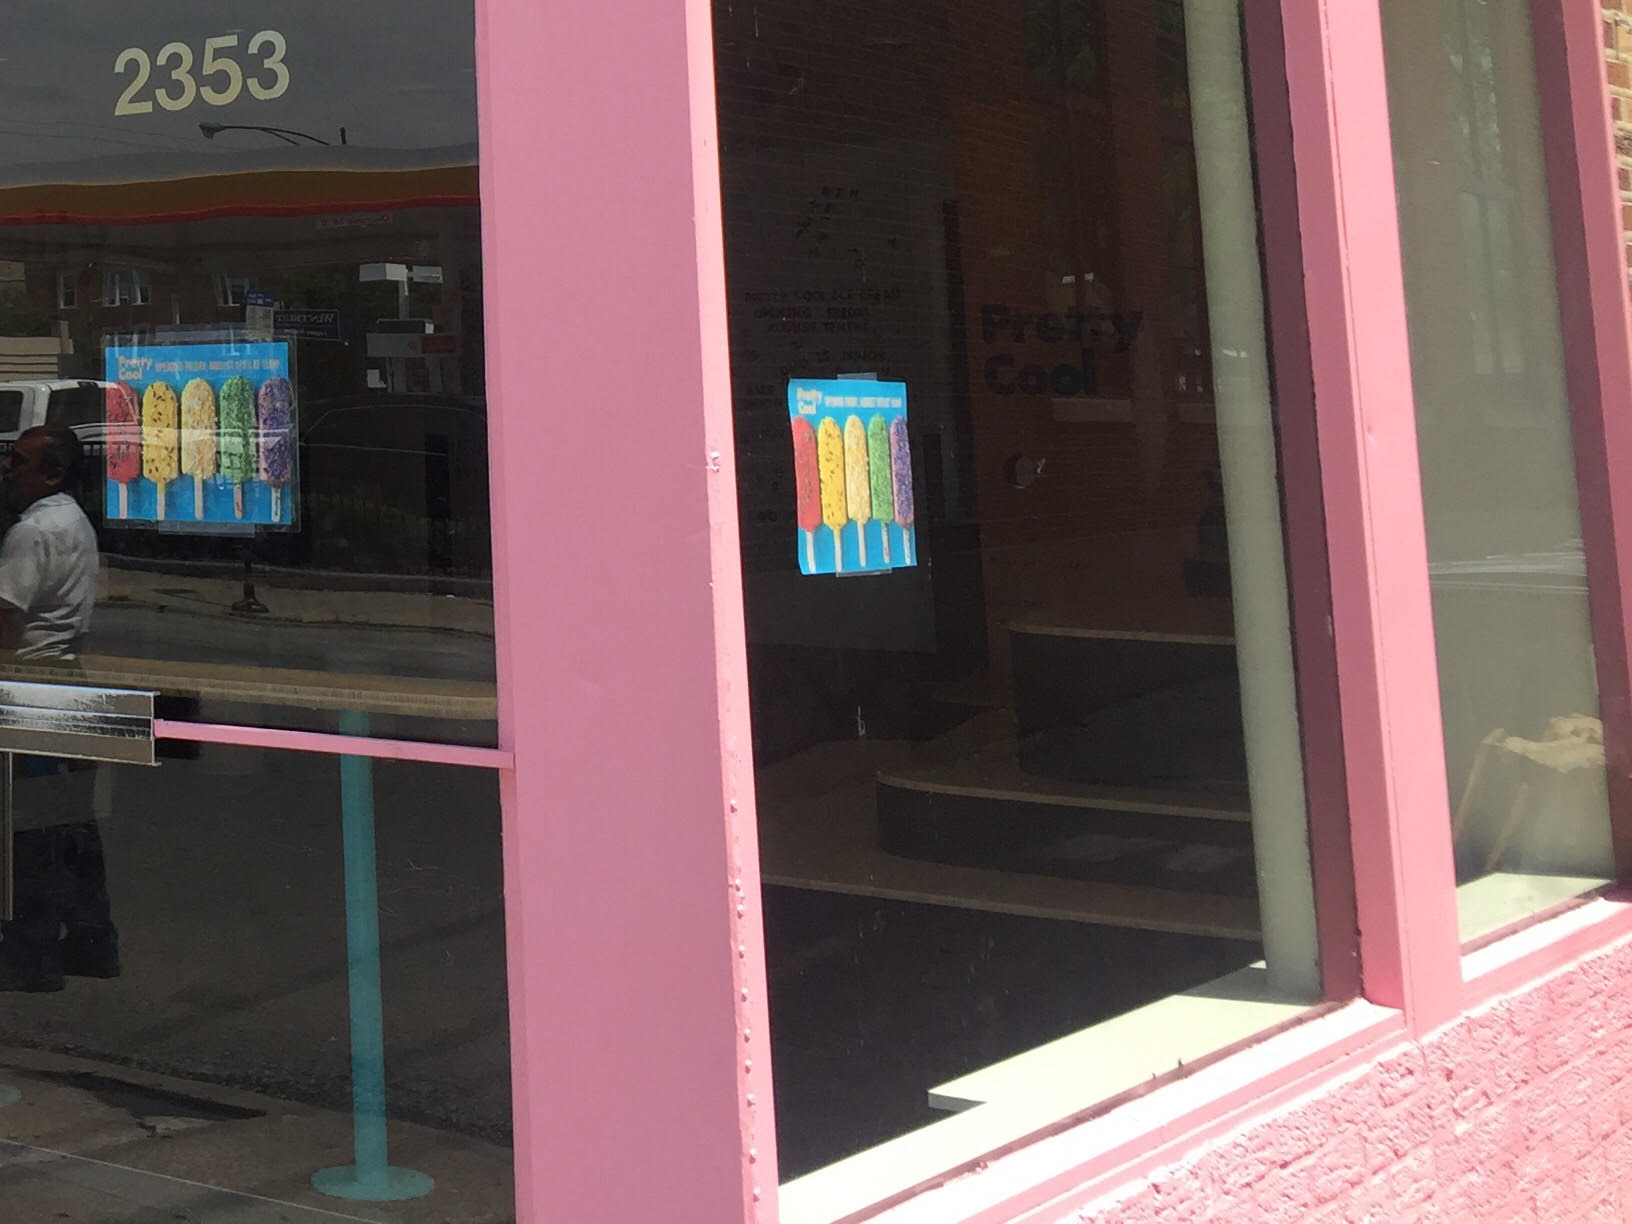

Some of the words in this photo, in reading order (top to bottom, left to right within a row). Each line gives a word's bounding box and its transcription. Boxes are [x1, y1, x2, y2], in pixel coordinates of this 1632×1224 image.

[113, 29, 291, 116] 2353
[118, 355, 154, 371] Pretty
[118, 368, 145, 381] Cool
[983, 350, 1097, 397] Cool
